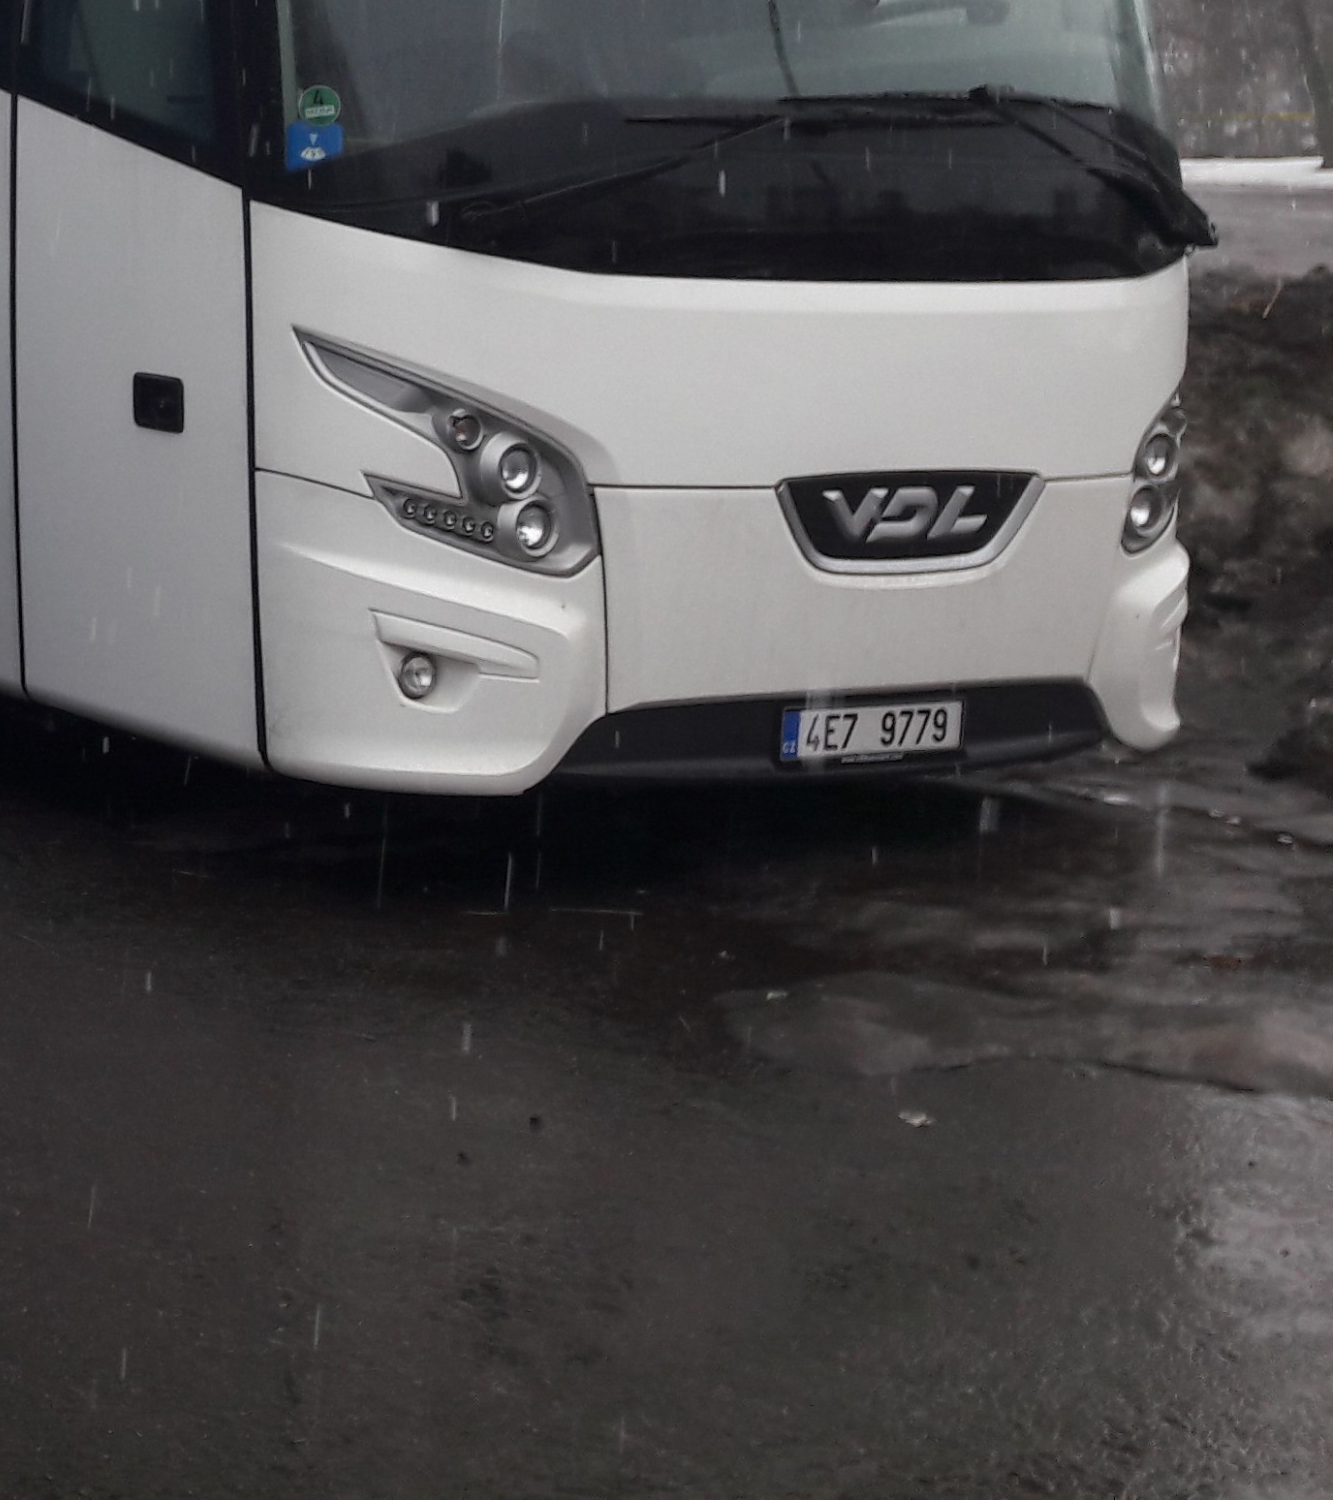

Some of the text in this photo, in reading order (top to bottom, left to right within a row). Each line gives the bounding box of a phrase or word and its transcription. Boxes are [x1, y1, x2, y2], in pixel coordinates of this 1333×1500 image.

[822, 485, 988, 544] VDL
[805, 707, 948, 751] 4E7 9779
